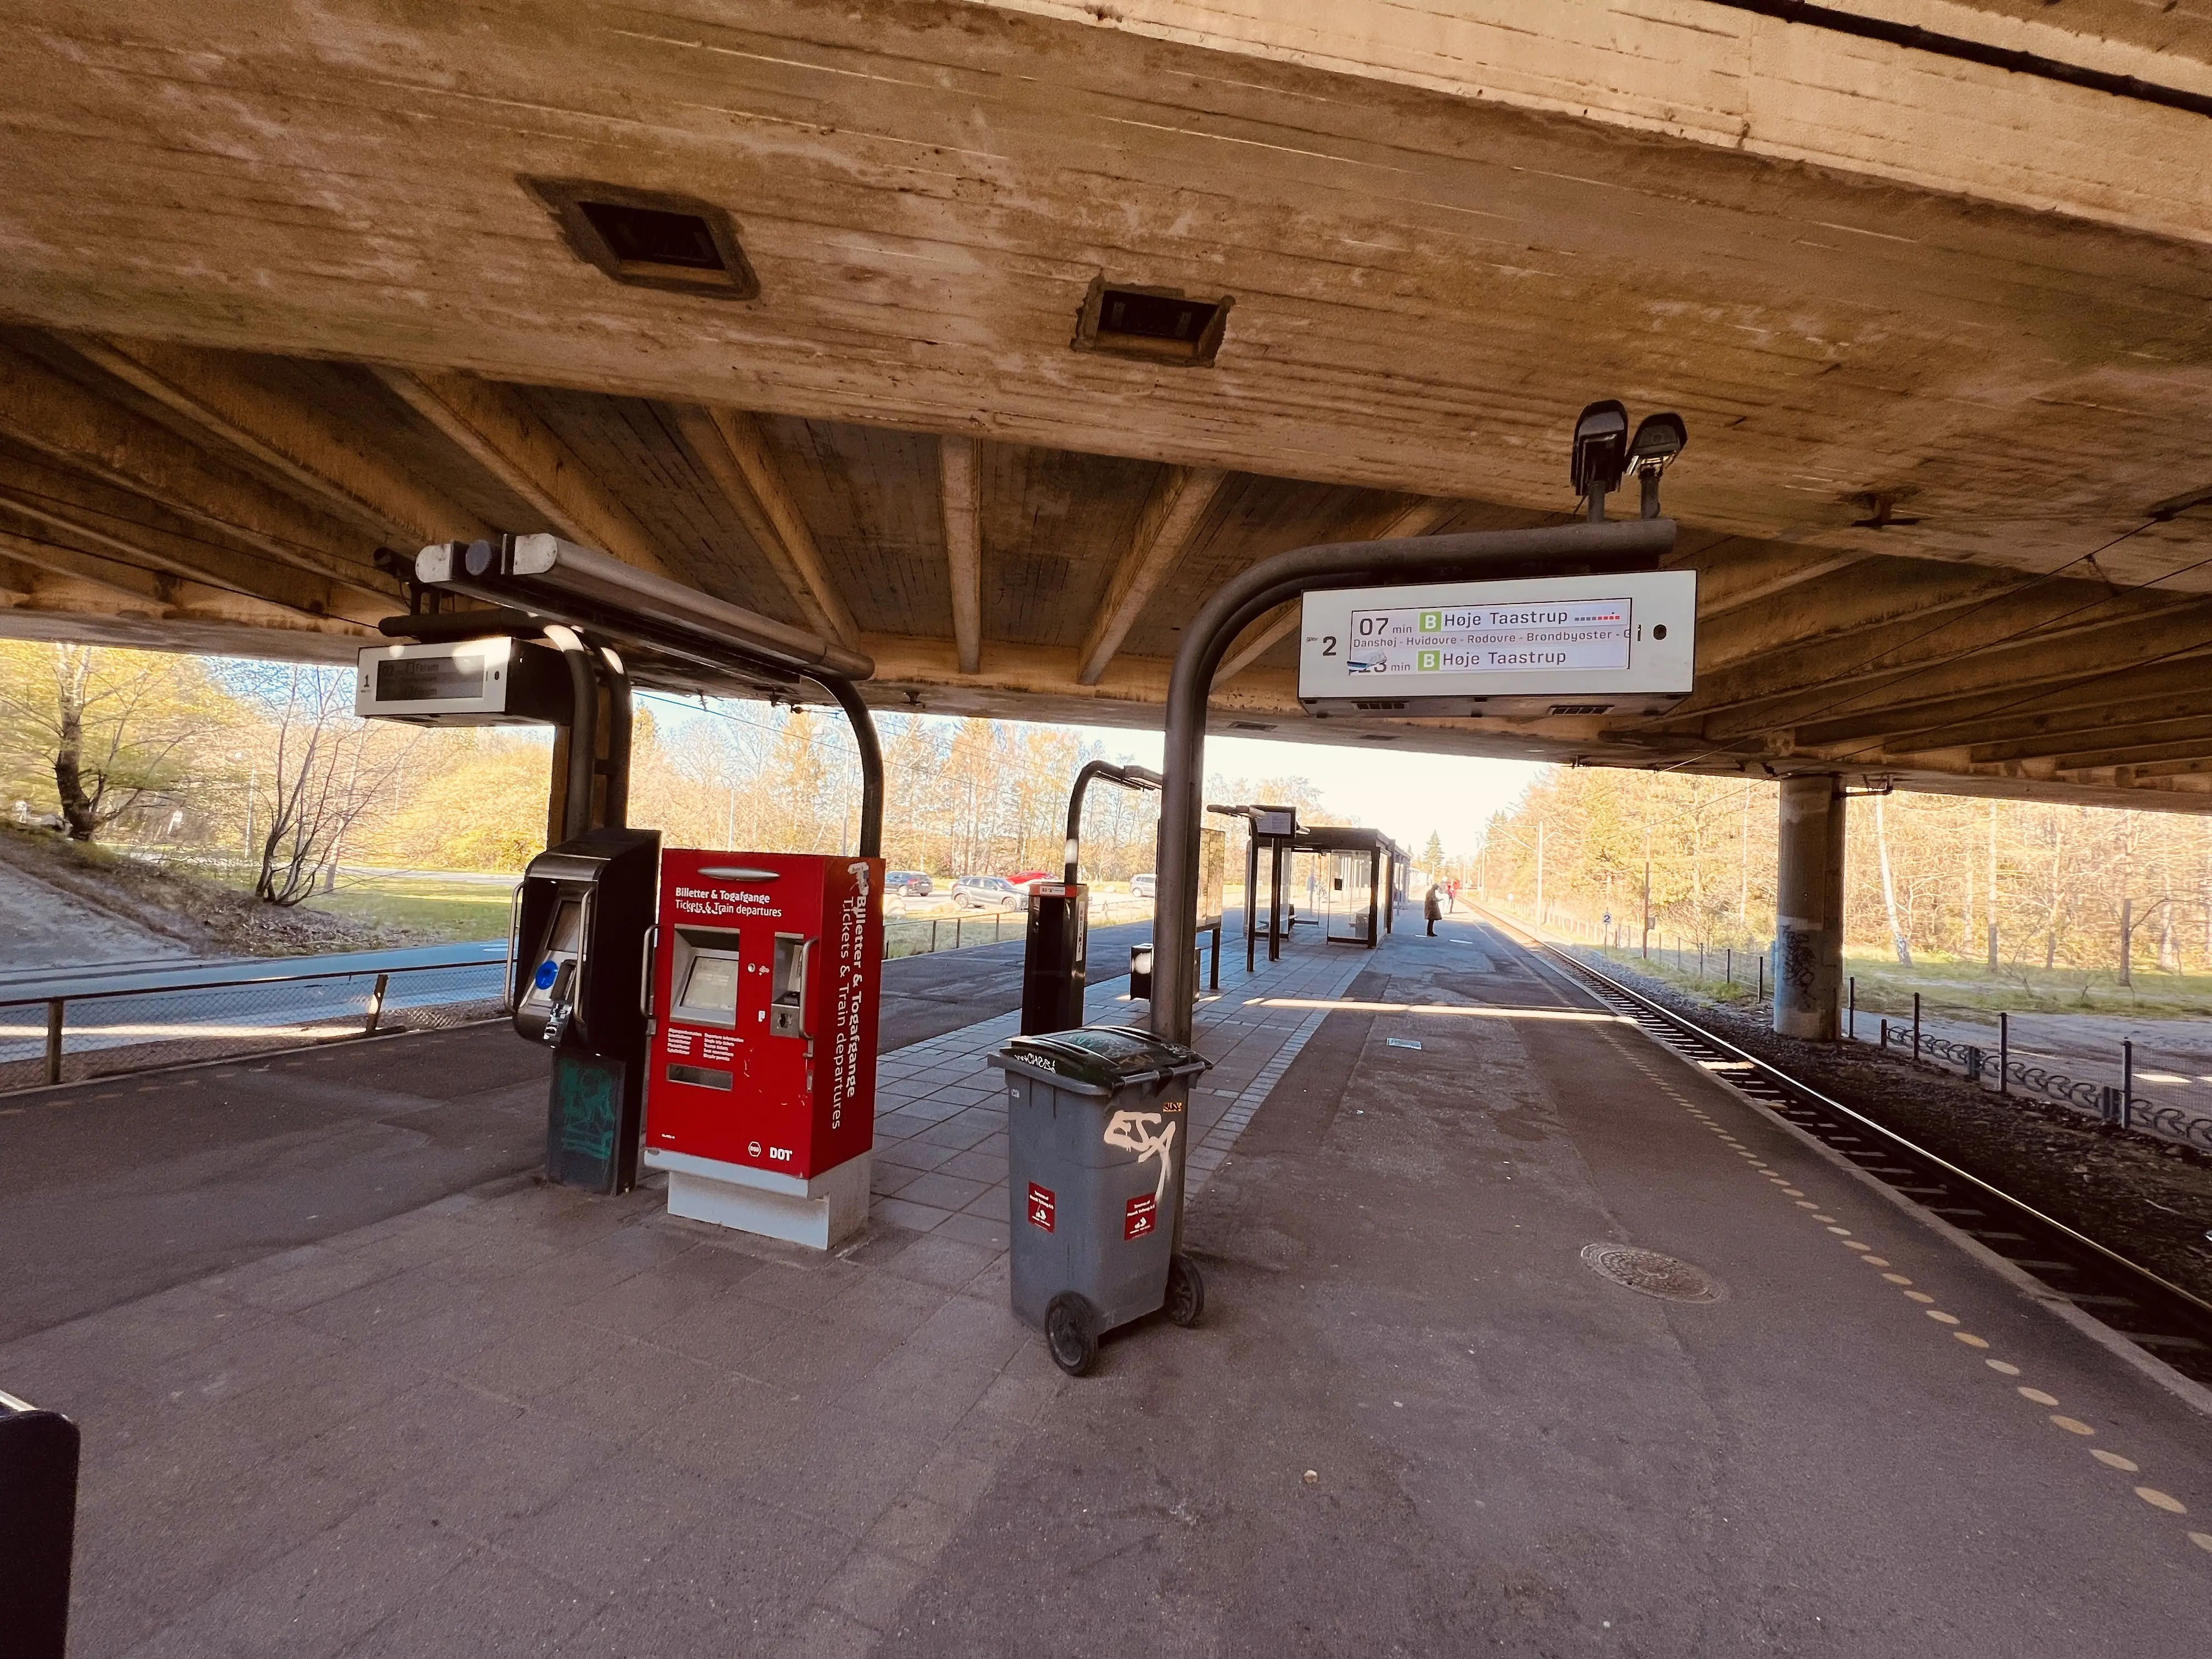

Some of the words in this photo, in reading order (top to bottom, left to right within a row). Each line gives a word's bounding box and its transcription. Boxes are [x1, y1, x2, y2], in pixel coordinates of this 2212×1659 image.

[1359, 618, 1389, 636] 07
[1392, 624, 1412, 634] min
[1425, 615, 1436, 629] B
[1444, 612, 1481, 628] Høje
[1489, 611, 1567, 624] Taastrup
[1323, 636, 1336, 656] 2
[1407, 636, 1457, 645] Hvidovre
[1391, 662, 1410, 671] min
[1423, 653, 1435, 668] B
[1443, 652, 1480, 667] Høje
[1488, 651, 1566, 665] Taastrup
[364, 674, 369, 687] 1
[675, 887, 709, 899] Billetter
[710, 889, 718, 899] &
[719, 890, 770, 904] Togafgange
[675, 899, 703, 913] Tickets
[705, 902, 712, 912] &
[713, 902, 734, 913] Train
[736, 904, 782, 917] departures
[840, 896, 854, 959] Tickets
[1604, 915, 1610, 923] 2
[853, 896, 866, 968] Billetter
[840, 965, 850, 978] &
[853, 974, 862, 988] &
[837, 983, 849, 1026] Train
[846, 991, 862, 1097] Togafgange
[832, 1033, 847, 1130] departures
[770, 1147, 792, 1161] DOT
